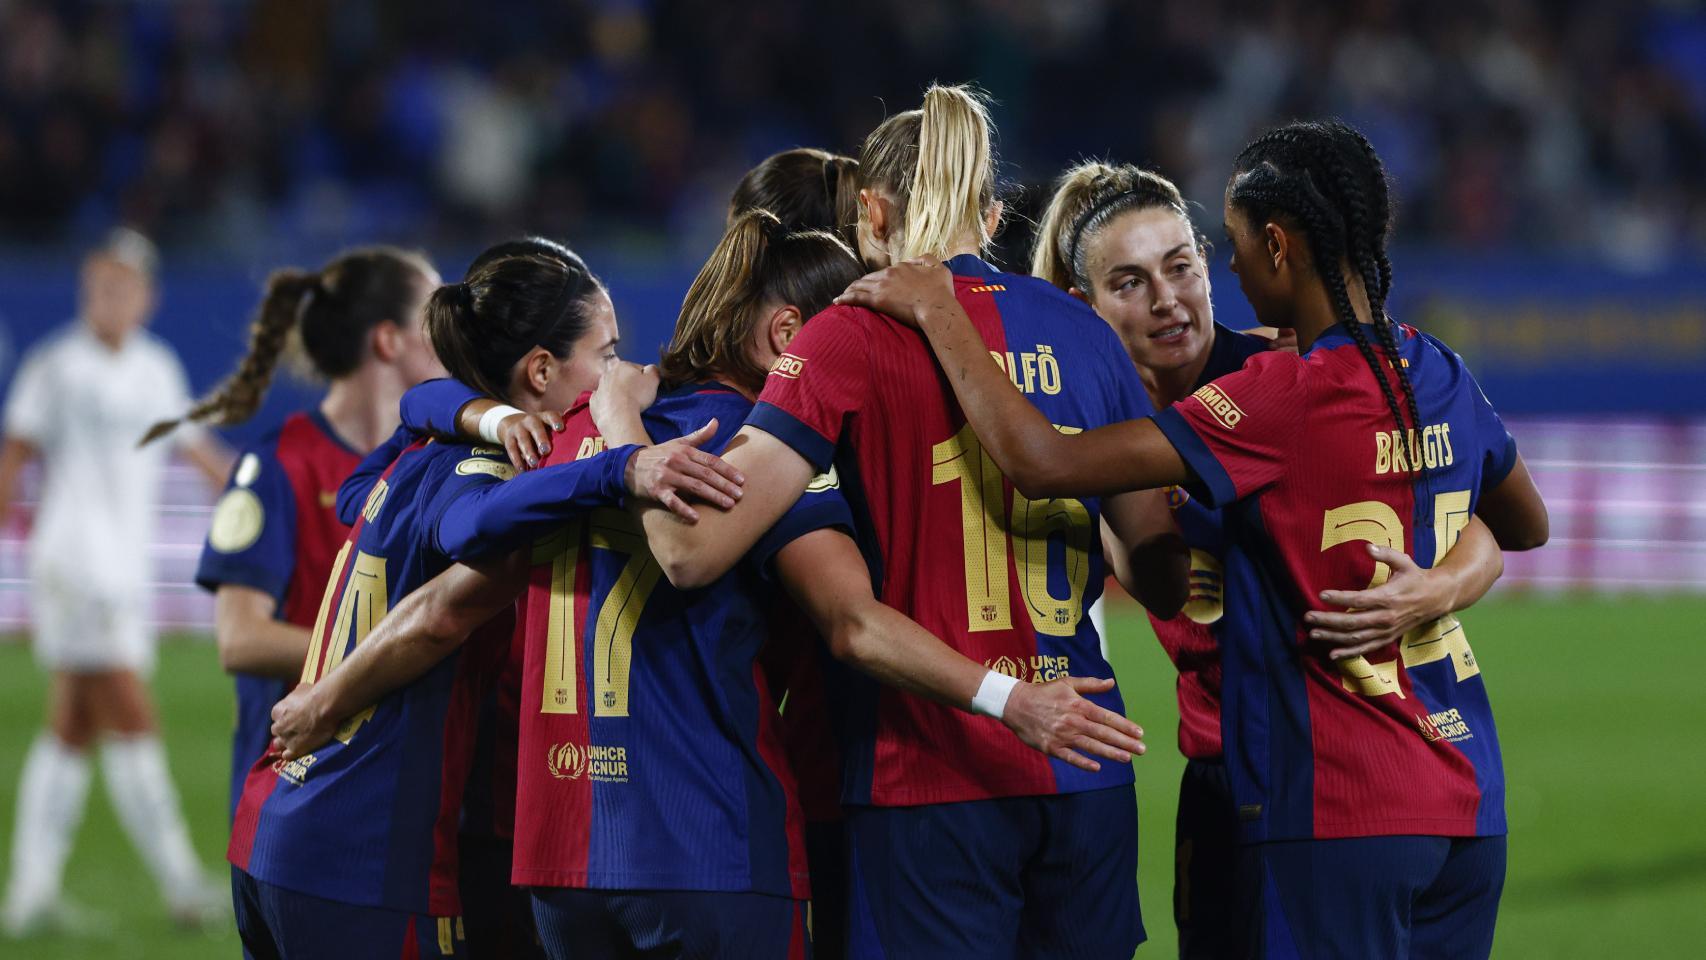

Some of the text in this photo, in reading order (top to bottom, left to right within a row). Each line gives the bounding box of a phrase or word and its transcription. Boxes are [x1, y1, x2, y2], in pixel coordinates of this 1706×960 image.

[988, 343, 1062, 396] LFÖ
[1375, 422, 1453, 475] BRUGTS
[932, 422, 1093, 637] 16
[531, 508, 666, 718] 17
[1320, 489, 1480, 699] 24
[587, 745, 627, 761] UNHCR
[587, 761, 628, 775] ACNUR
